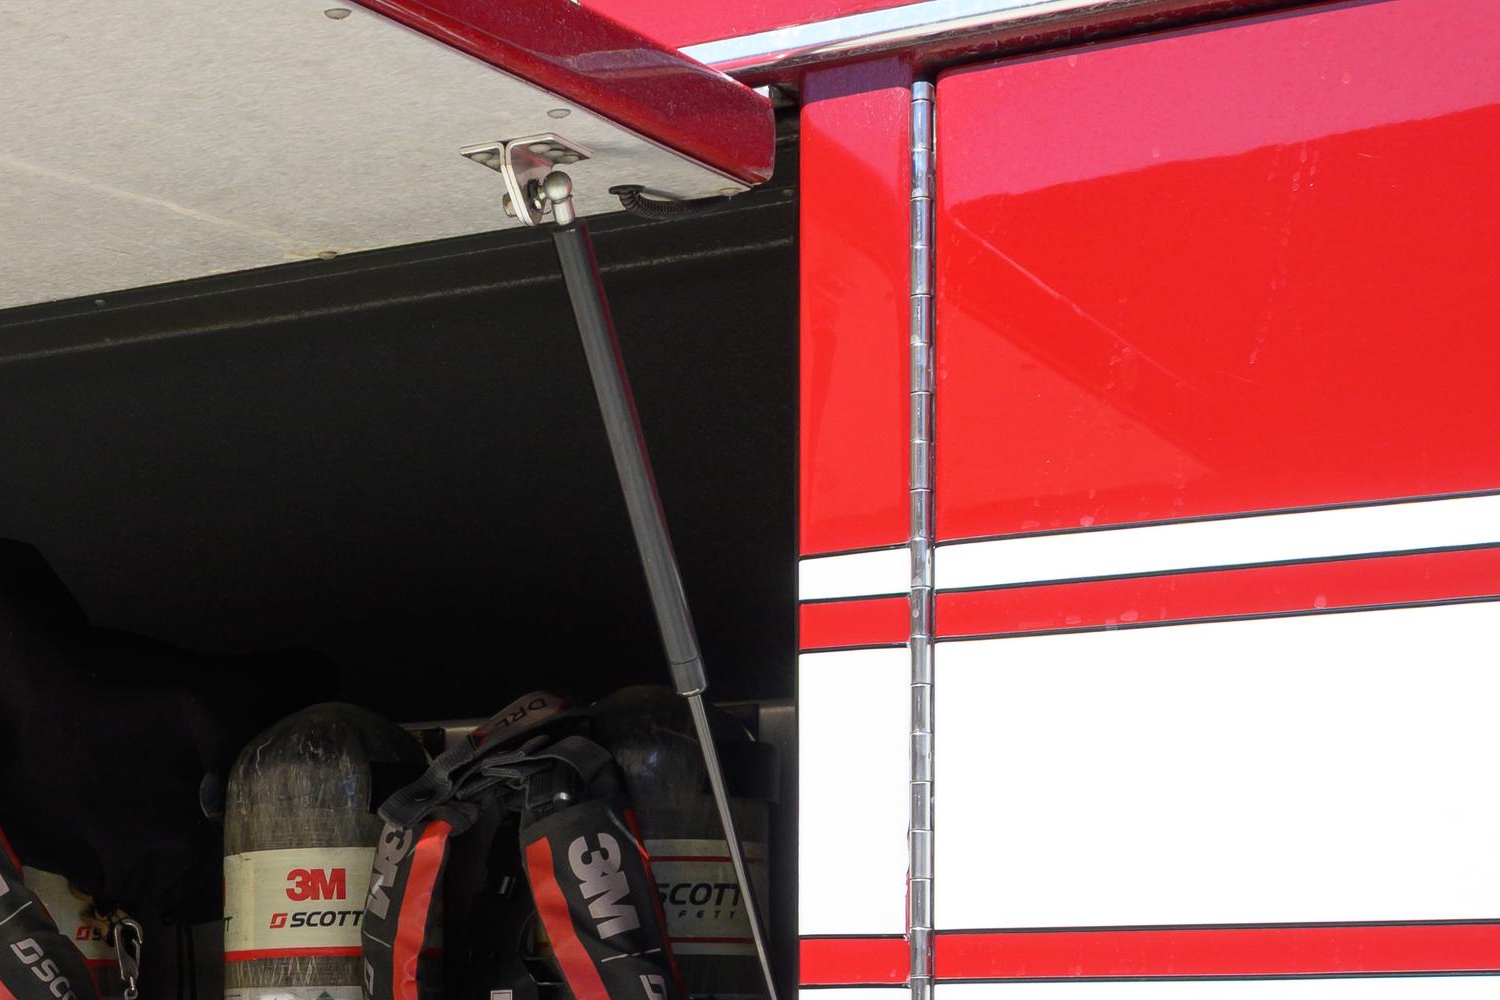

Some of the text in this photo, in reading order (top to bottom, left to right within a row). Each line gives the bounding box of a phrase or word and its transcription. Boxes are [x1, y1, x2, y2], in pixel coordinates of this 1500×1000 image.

[285, 867, 347, 902] 3M
[367, 822, 413, 920] 3M
[567, 832, 641, 940] 3M
[290, 910, 364, 928] SCOTT
